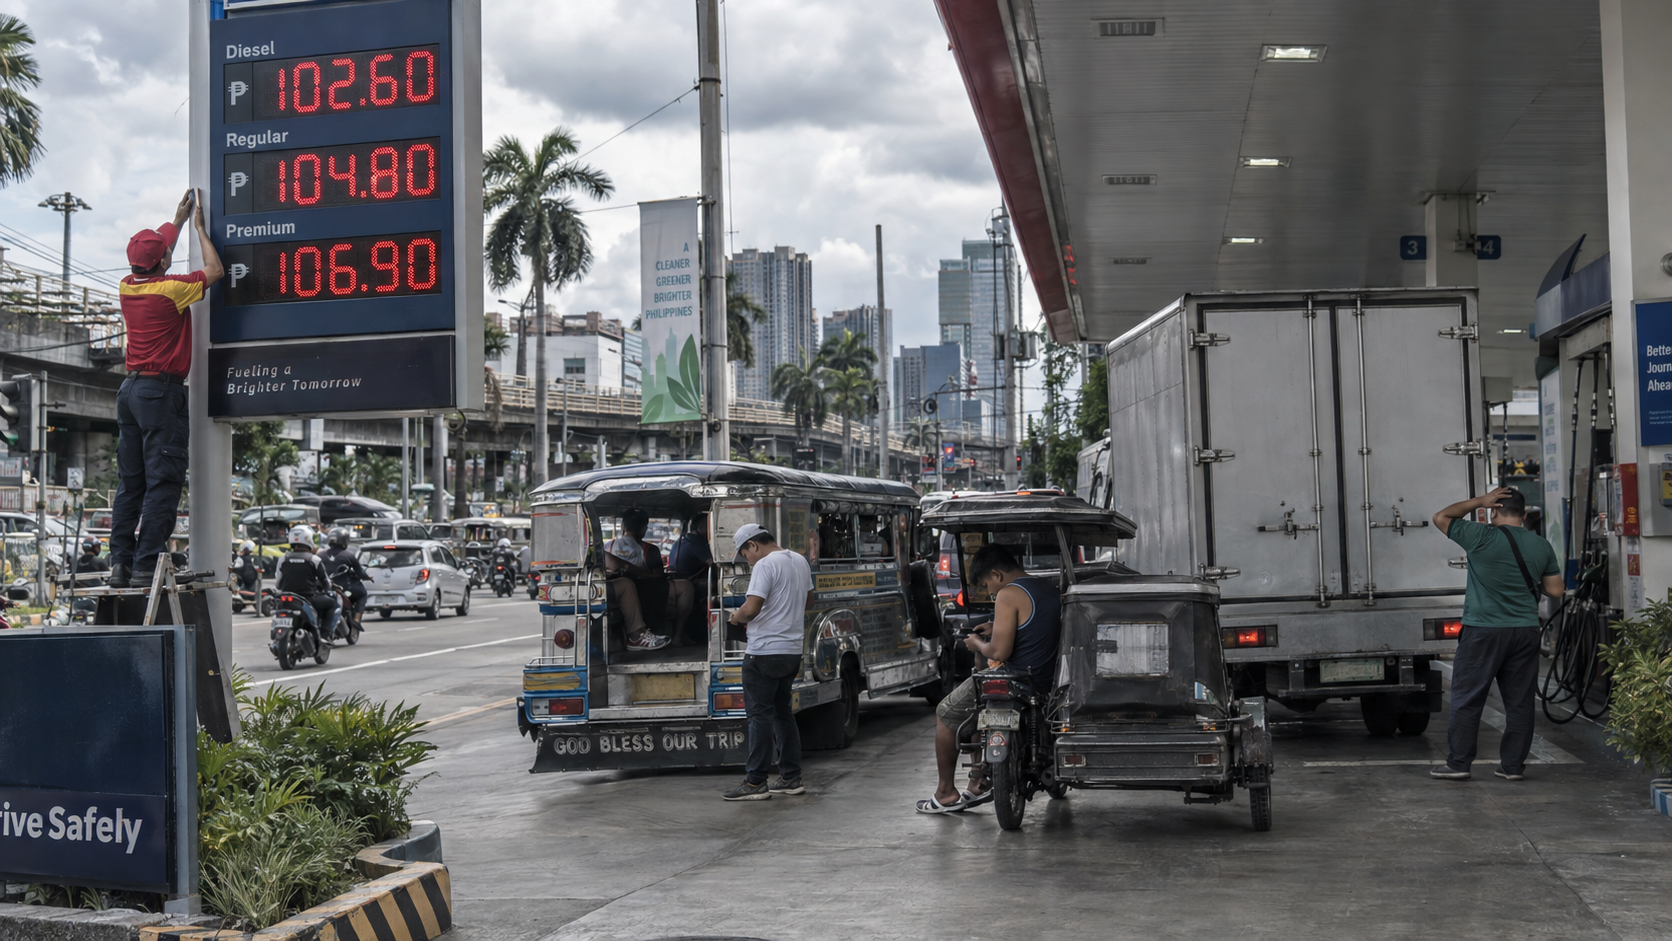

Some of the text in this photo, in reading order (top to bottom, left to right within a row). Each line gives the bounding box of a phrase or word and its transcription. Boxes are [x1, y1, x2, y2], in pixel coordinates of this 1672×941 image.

[226, 41, 275, 59] Diesel
[278, 50, 435, 113] 102.60
[226, 130, 289, 149] Regular
[278, 143, 436, 206] 104.80
[226, 221, 296, 239] Premium
[683, 242, 689, 252] A
[1407, 240, 1419, 255] 3
[1482, 240, 1495, 255] 4
[279, 238, 436, 297] 106.90
[655, 258, 690, 271] CLEANER
[656, 275, 691, 287] GREENER
[654, 291, 692, 303] BRIGHTER
[645, 306, 693, 319] PHILIPPINES
[1646, 345, 1672, 357] Bette
[227, 365, 292, 378] Fueling a
[227, 378, 362, 396] Brighter Tomorrow
[1647, 379, 1672, 392] Ahea
[553, 731, 746, 755] GOD BLESS OUR TRIP
[0, 801, 143, 854] ive Safely
